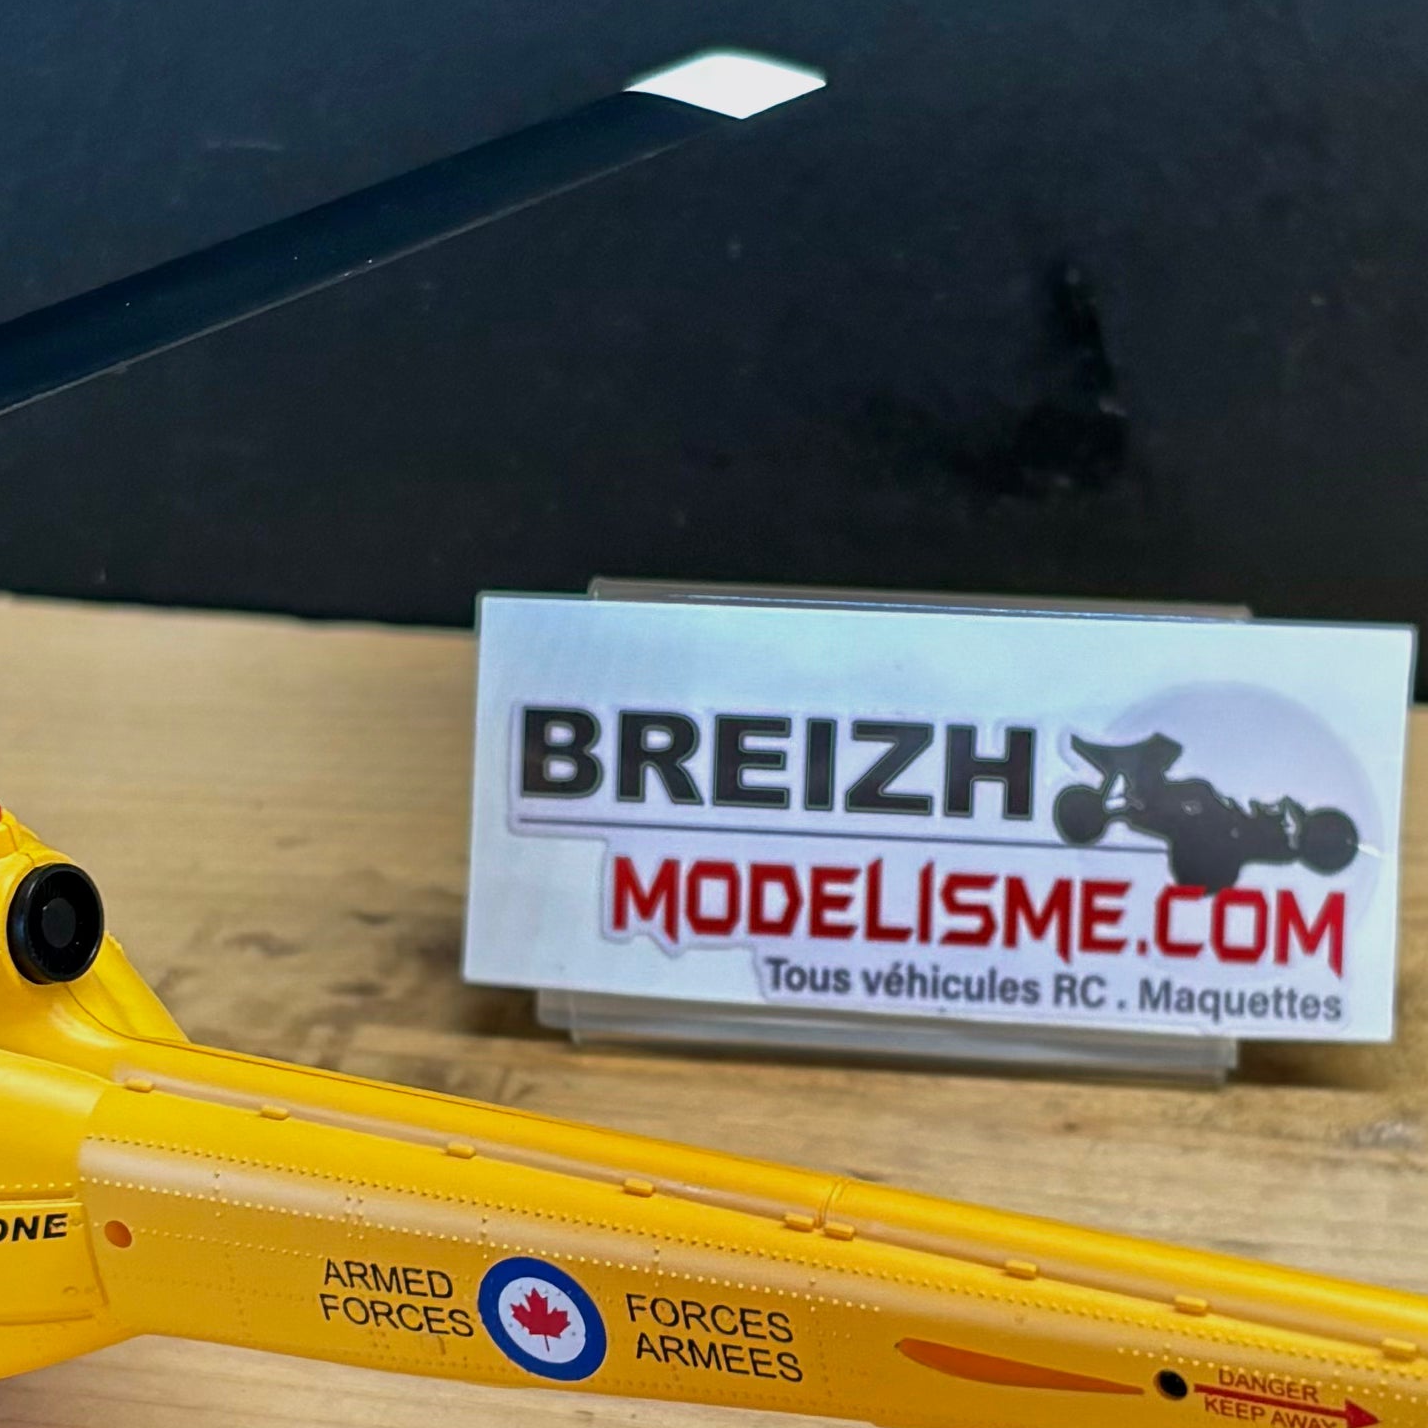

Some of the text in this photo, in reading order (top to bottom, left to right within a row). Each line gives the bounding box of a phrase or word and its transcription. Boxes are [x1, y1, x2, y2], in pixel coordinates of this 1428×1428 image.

[521, 705, 1037, 822] BREIZH
[611, 856, 1346, 978] MODELISME.COM
[765, 956, 851, 994] Tous
[862, 962, 1040, 1004] véhicules
[1054, 974, 1107, 1008] RC
[1139, 977, 1342, 1022] Maquettes
[323, 1258, 453, 1299] ARMED
[319, 1293, 474, 1337] FORCES
[626, 1293, 794, 1343] FORCES
[636, 1332, 804, 1382] ARMEES
[1204, 1396, 1265, 1421] KEEP
[1218, 1369, 1319, 1403] DANGER
